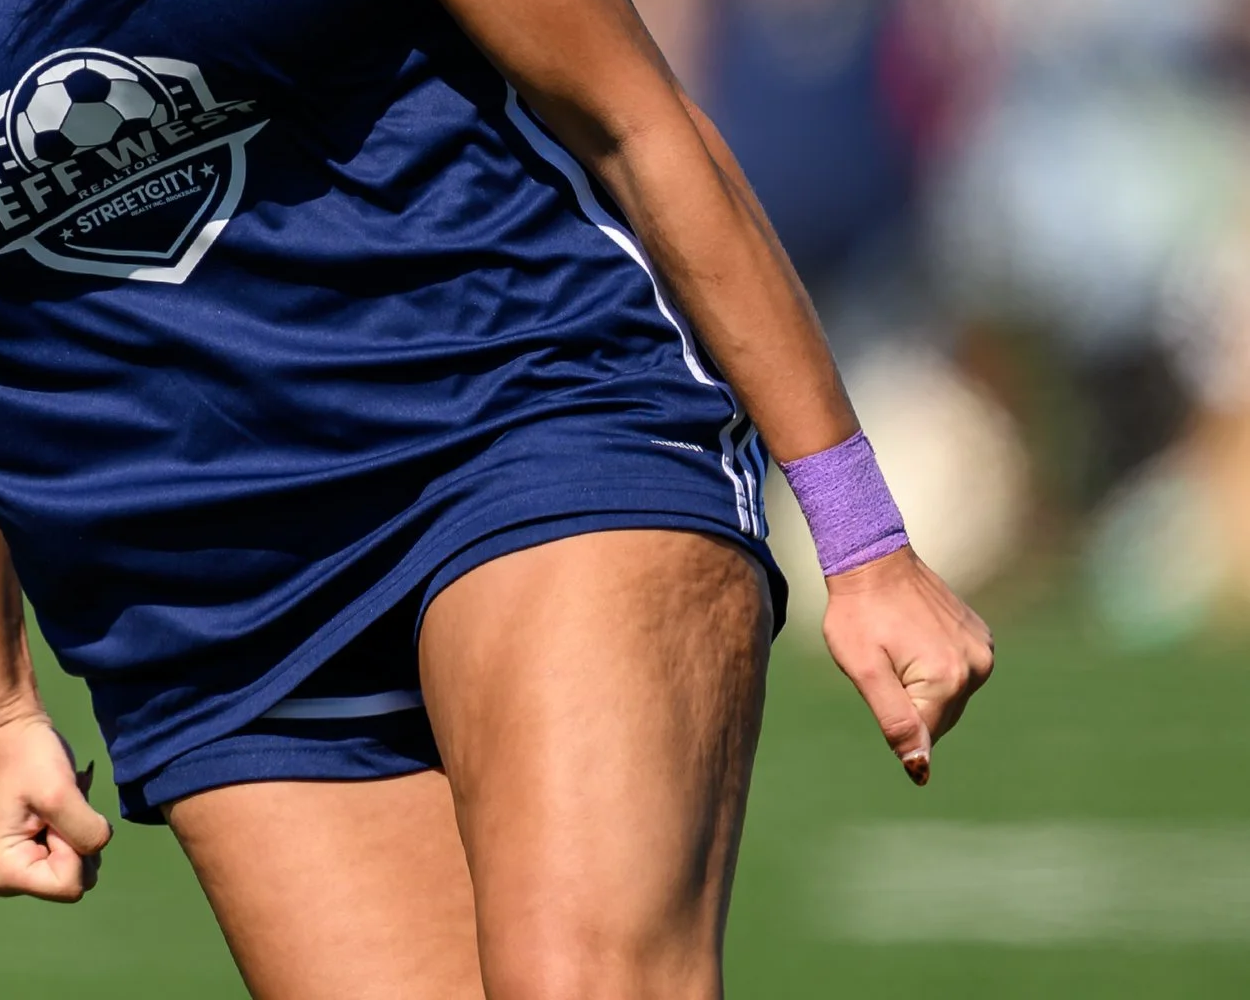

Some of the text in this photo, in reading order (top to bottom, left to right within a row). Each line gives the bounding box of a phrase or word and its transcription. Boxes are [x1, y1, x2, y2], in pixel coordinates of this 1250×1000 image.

[95, 99, 257, 171] WEST
[130, 203, 152, 217] REALTY
[166, 185, 201, 203] BROKERAGE
